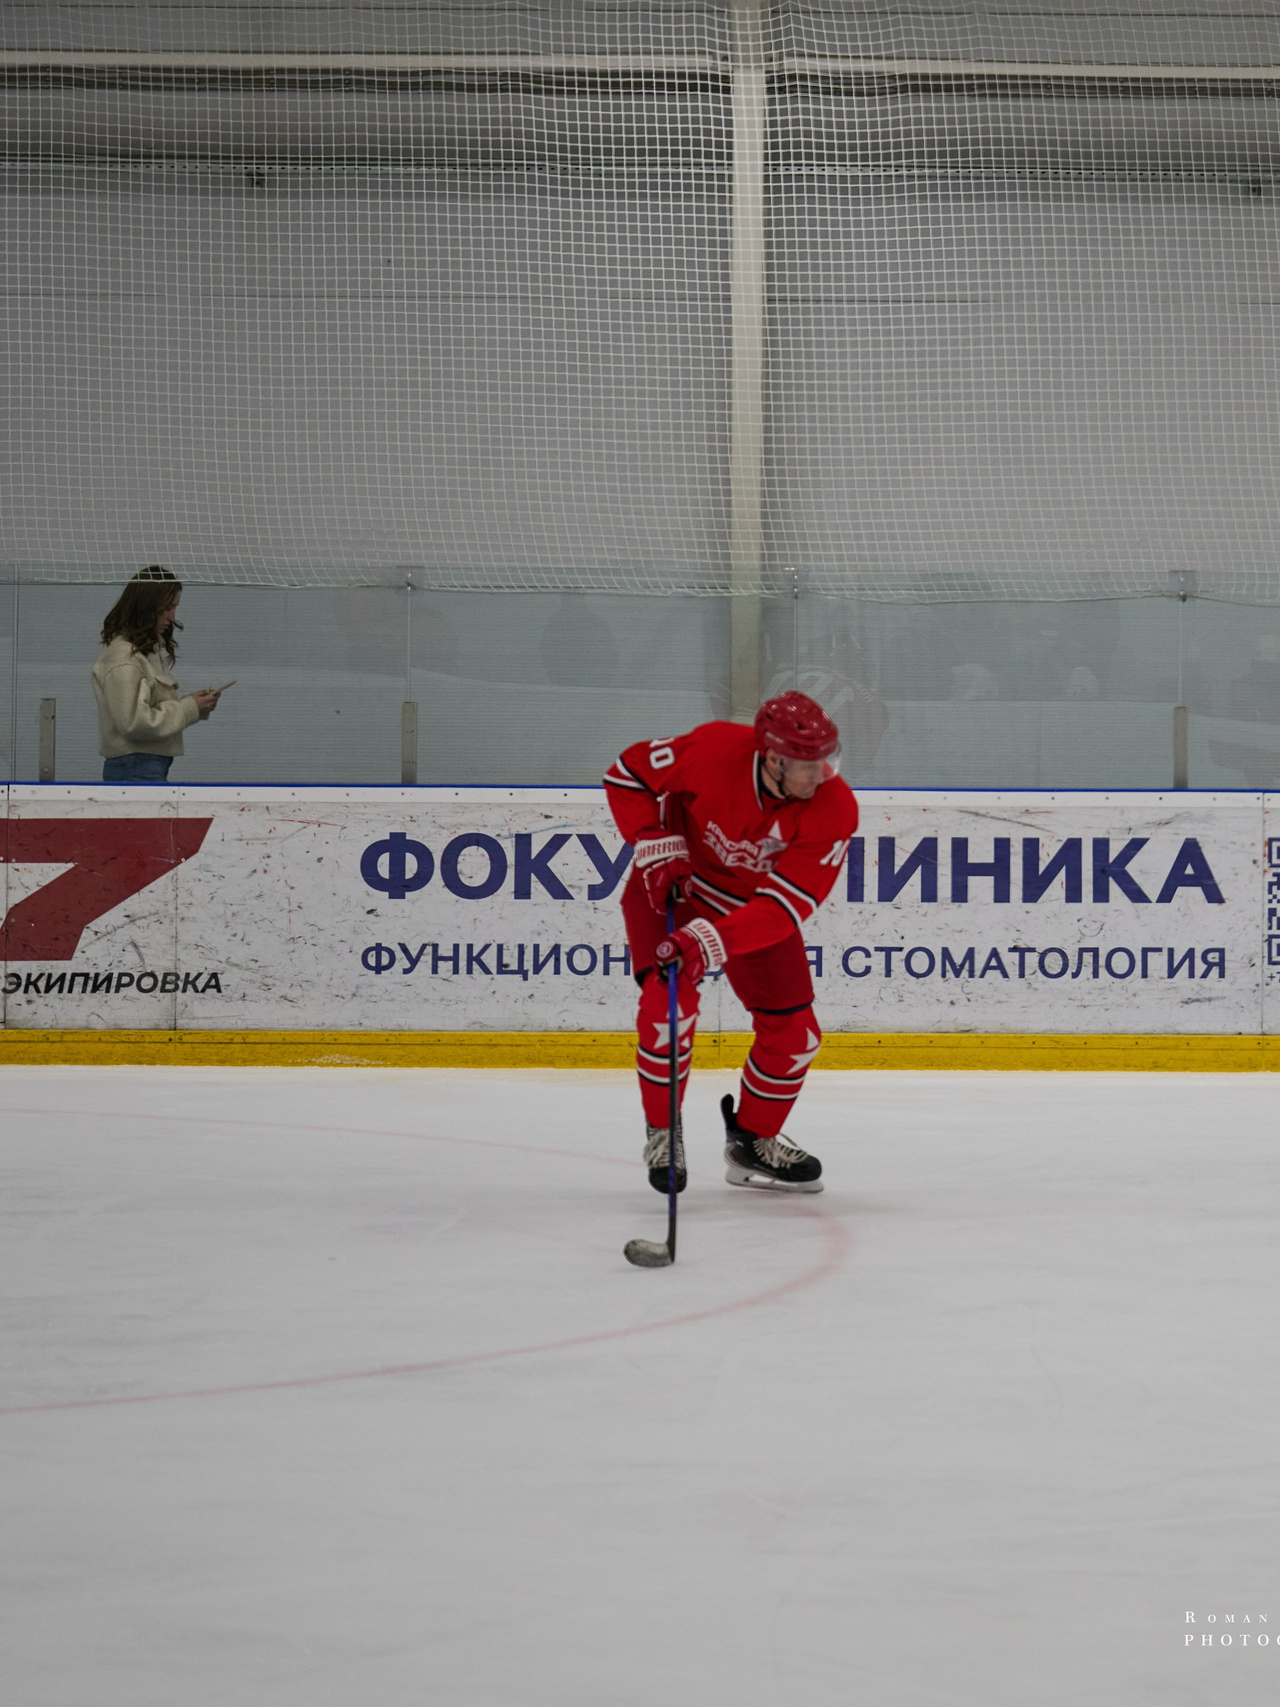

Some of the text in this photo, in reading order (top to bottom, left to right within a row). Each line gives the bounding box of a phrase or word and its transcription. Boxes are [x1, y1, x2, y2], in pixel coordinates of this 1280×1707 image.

[360, 831, 637, 901] ФОКУ
[841, 946, 1225, 979] СТОМАТОЛОГИЯ
[1, 971, 223, 994] ЭКИПИРОВКА
